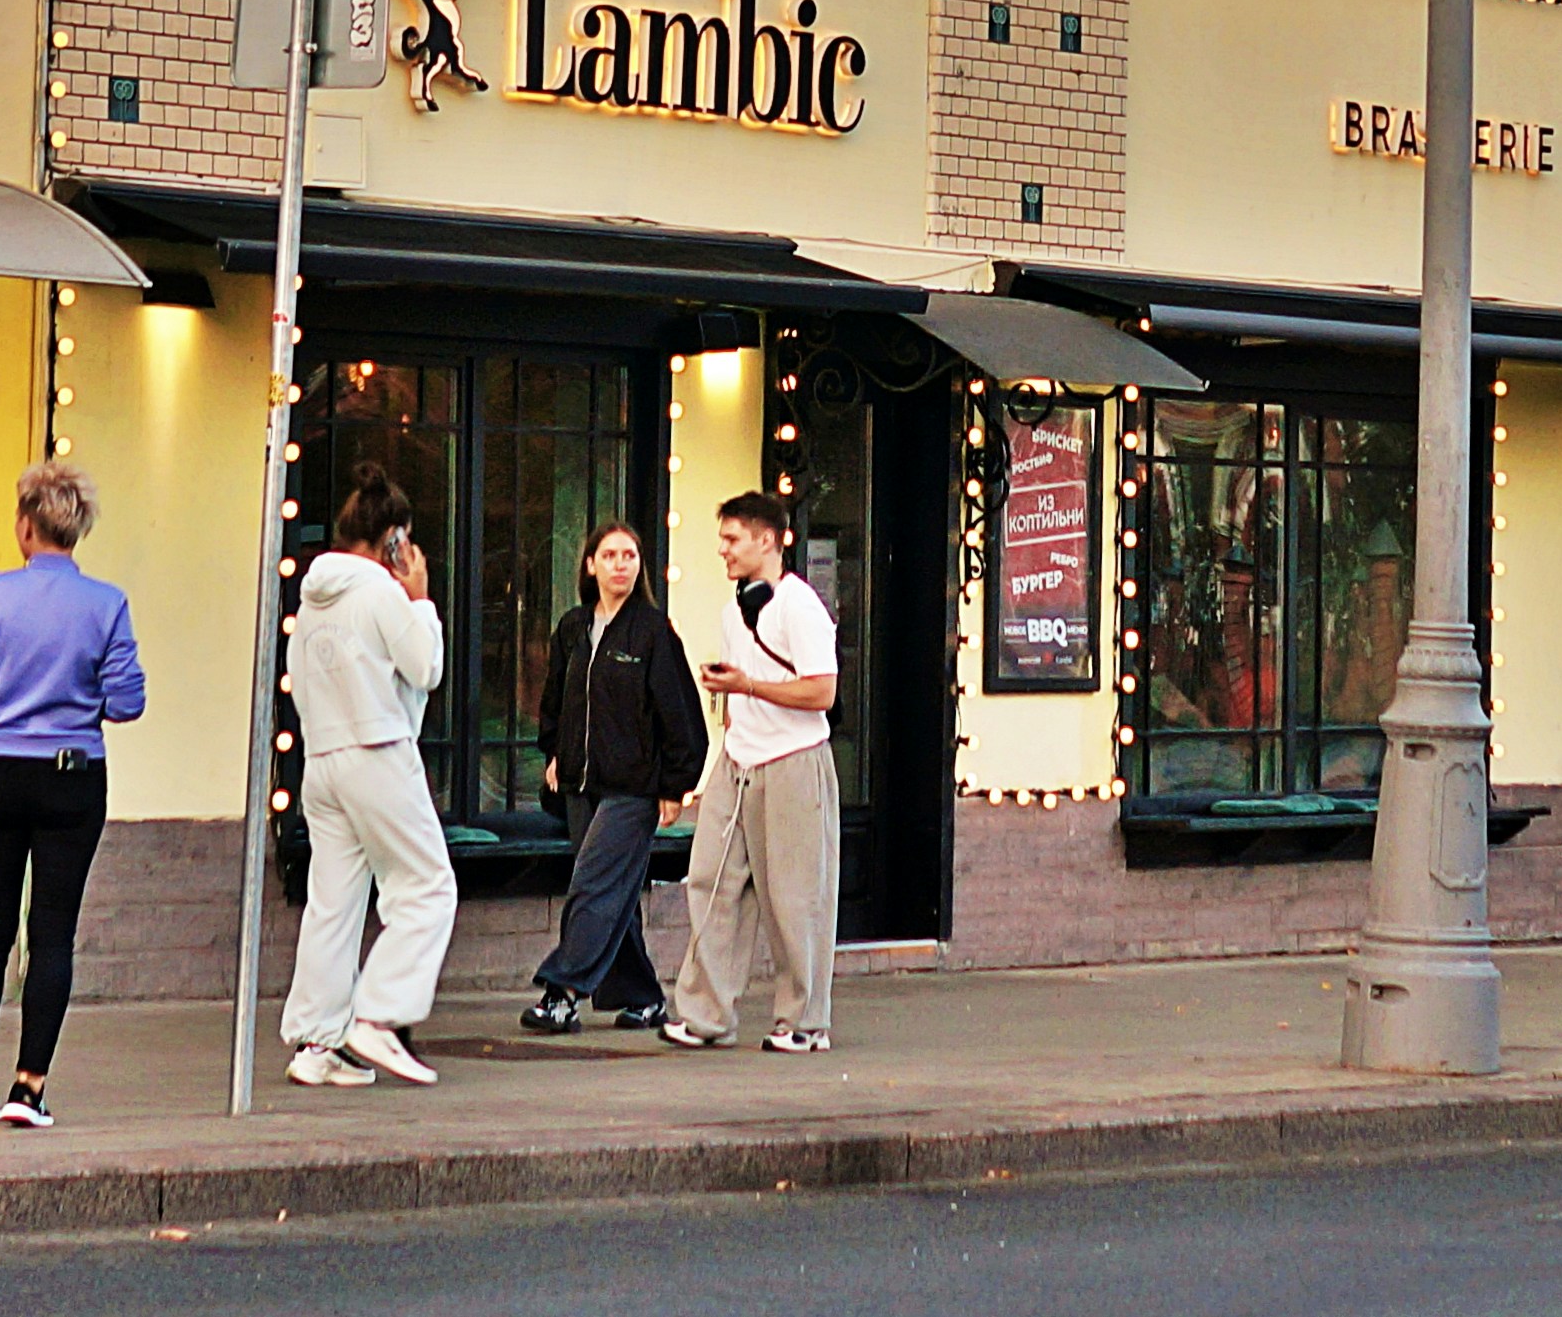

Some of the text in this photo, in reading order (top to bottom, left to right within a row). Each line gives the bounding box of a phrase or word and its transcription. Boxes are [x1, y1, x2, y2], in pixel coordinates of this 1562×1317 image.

[1343, 100, 1555, 172] BRAERIE
[1037, 494, 1055, 512] ИЗ
[1008, 507, 1084, 534] КОПТИЛЬНИ
[1011, 569, 1064, 595] БУРГЕР
[1026, 617, 1068, 647] BBQ
